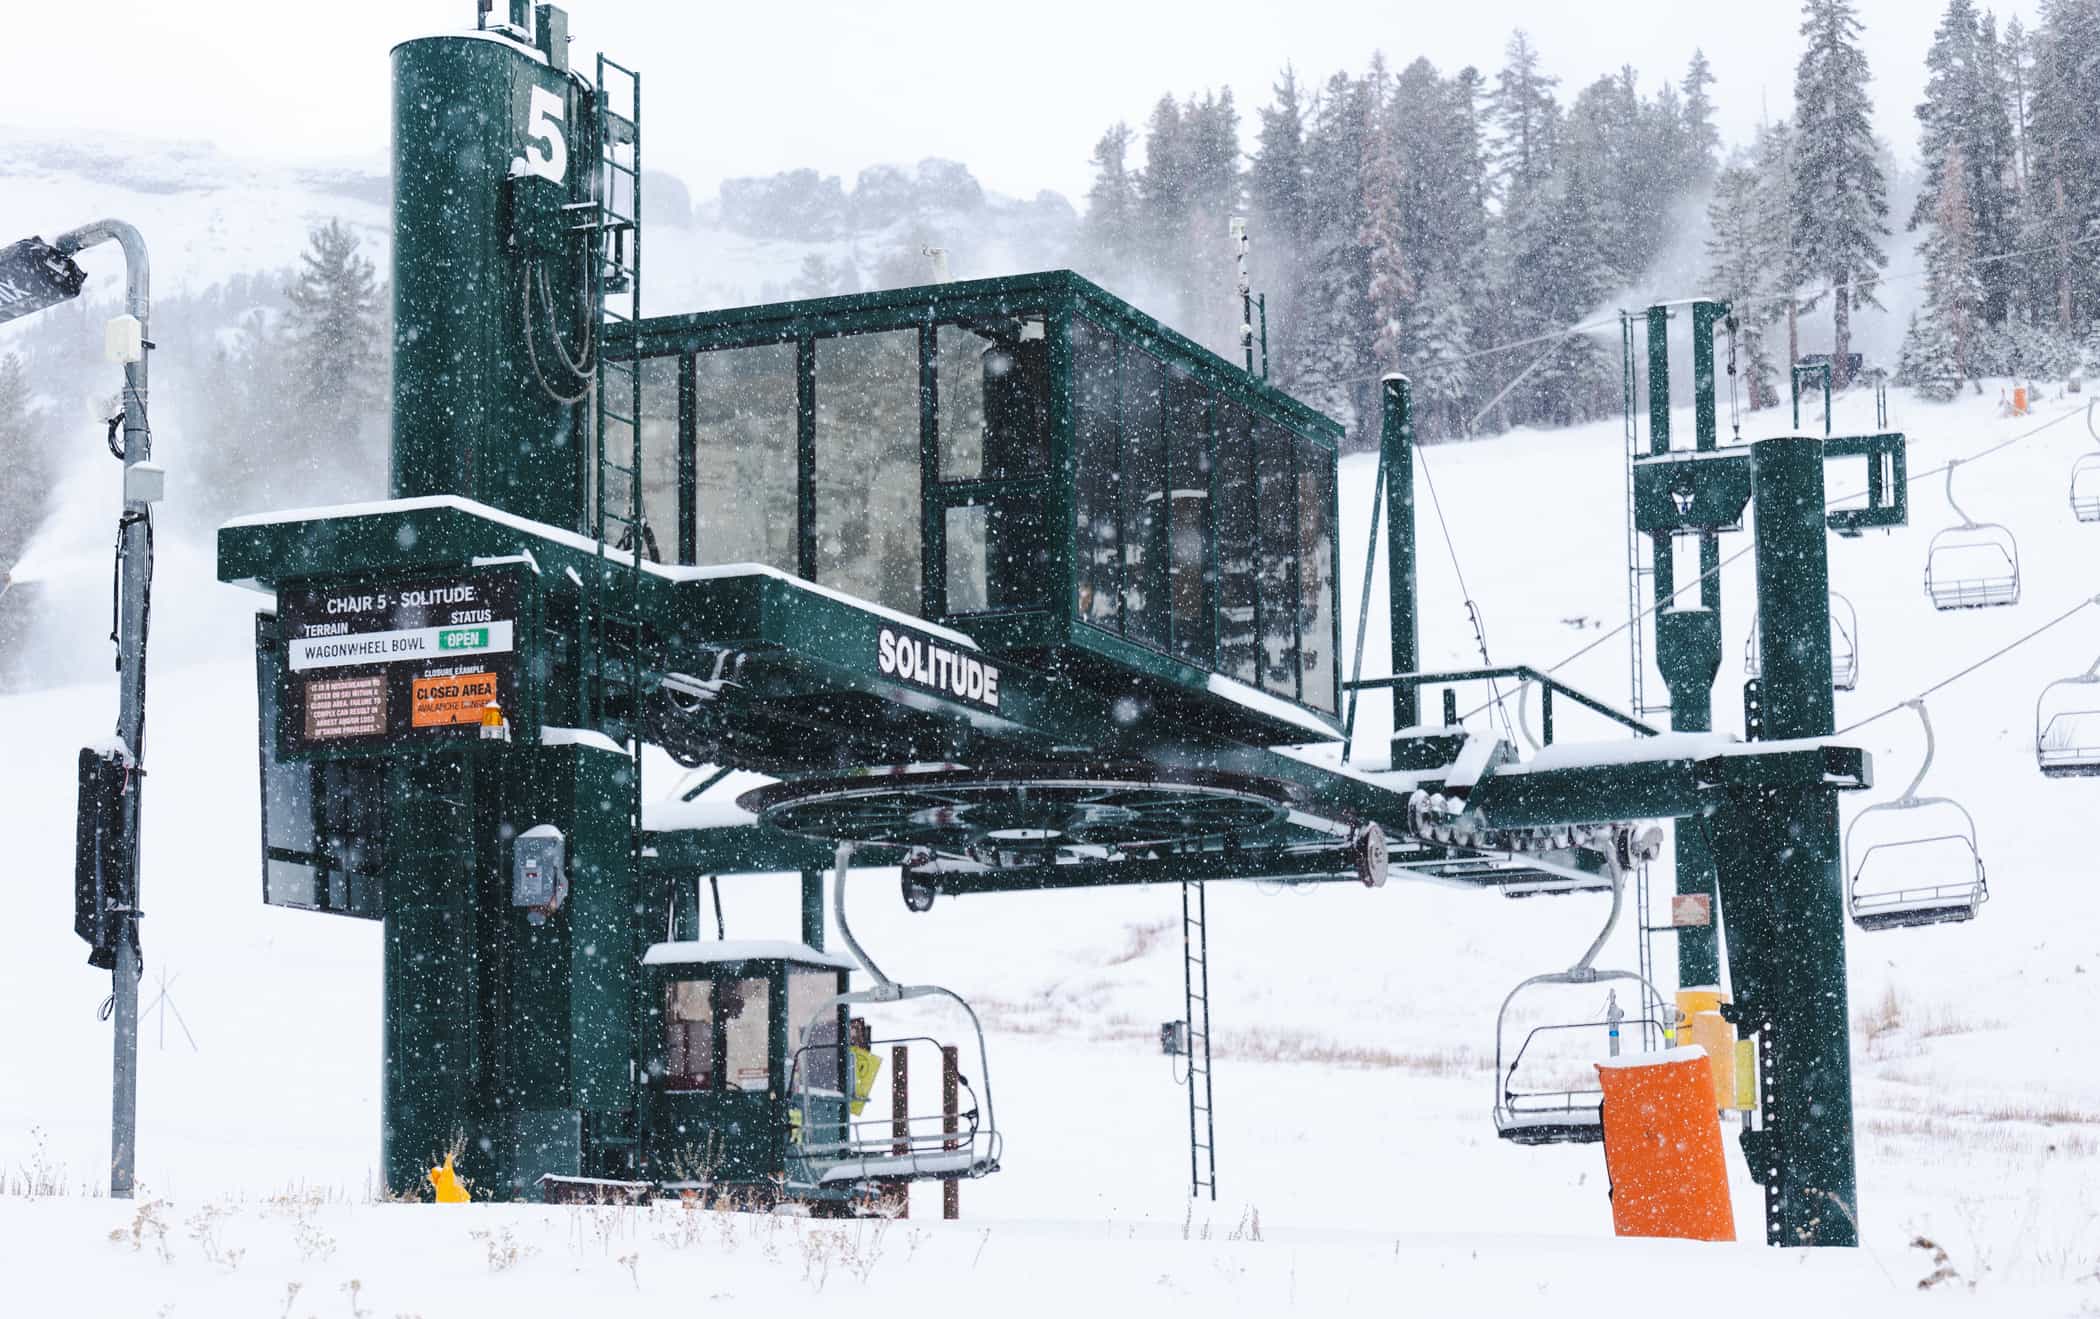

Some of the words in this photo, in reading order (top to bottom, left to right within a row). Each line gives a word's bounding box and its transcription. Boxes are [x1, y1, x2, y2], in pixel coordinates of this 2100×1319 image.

[526, 84, 567, 184] 5
[327, 596, 372, 614] CHAIR
[377, 594, 387, 610] 5
[401, 586, 475, 608] SOLITUDE
[451, 609, 492, 624] STATUS
[304, 622, 348, 637] TERRAIN
[447, 632, 479, 647] OPEN
[305, 641, 388, 660] WAGONWHEEL
[392, 637, 424, 653] BOWL
[879, 629, 998, 707] SOLITUDE
[417, 686, 459, 700] CLOSED
[462, 682, 492, 696] AREA
